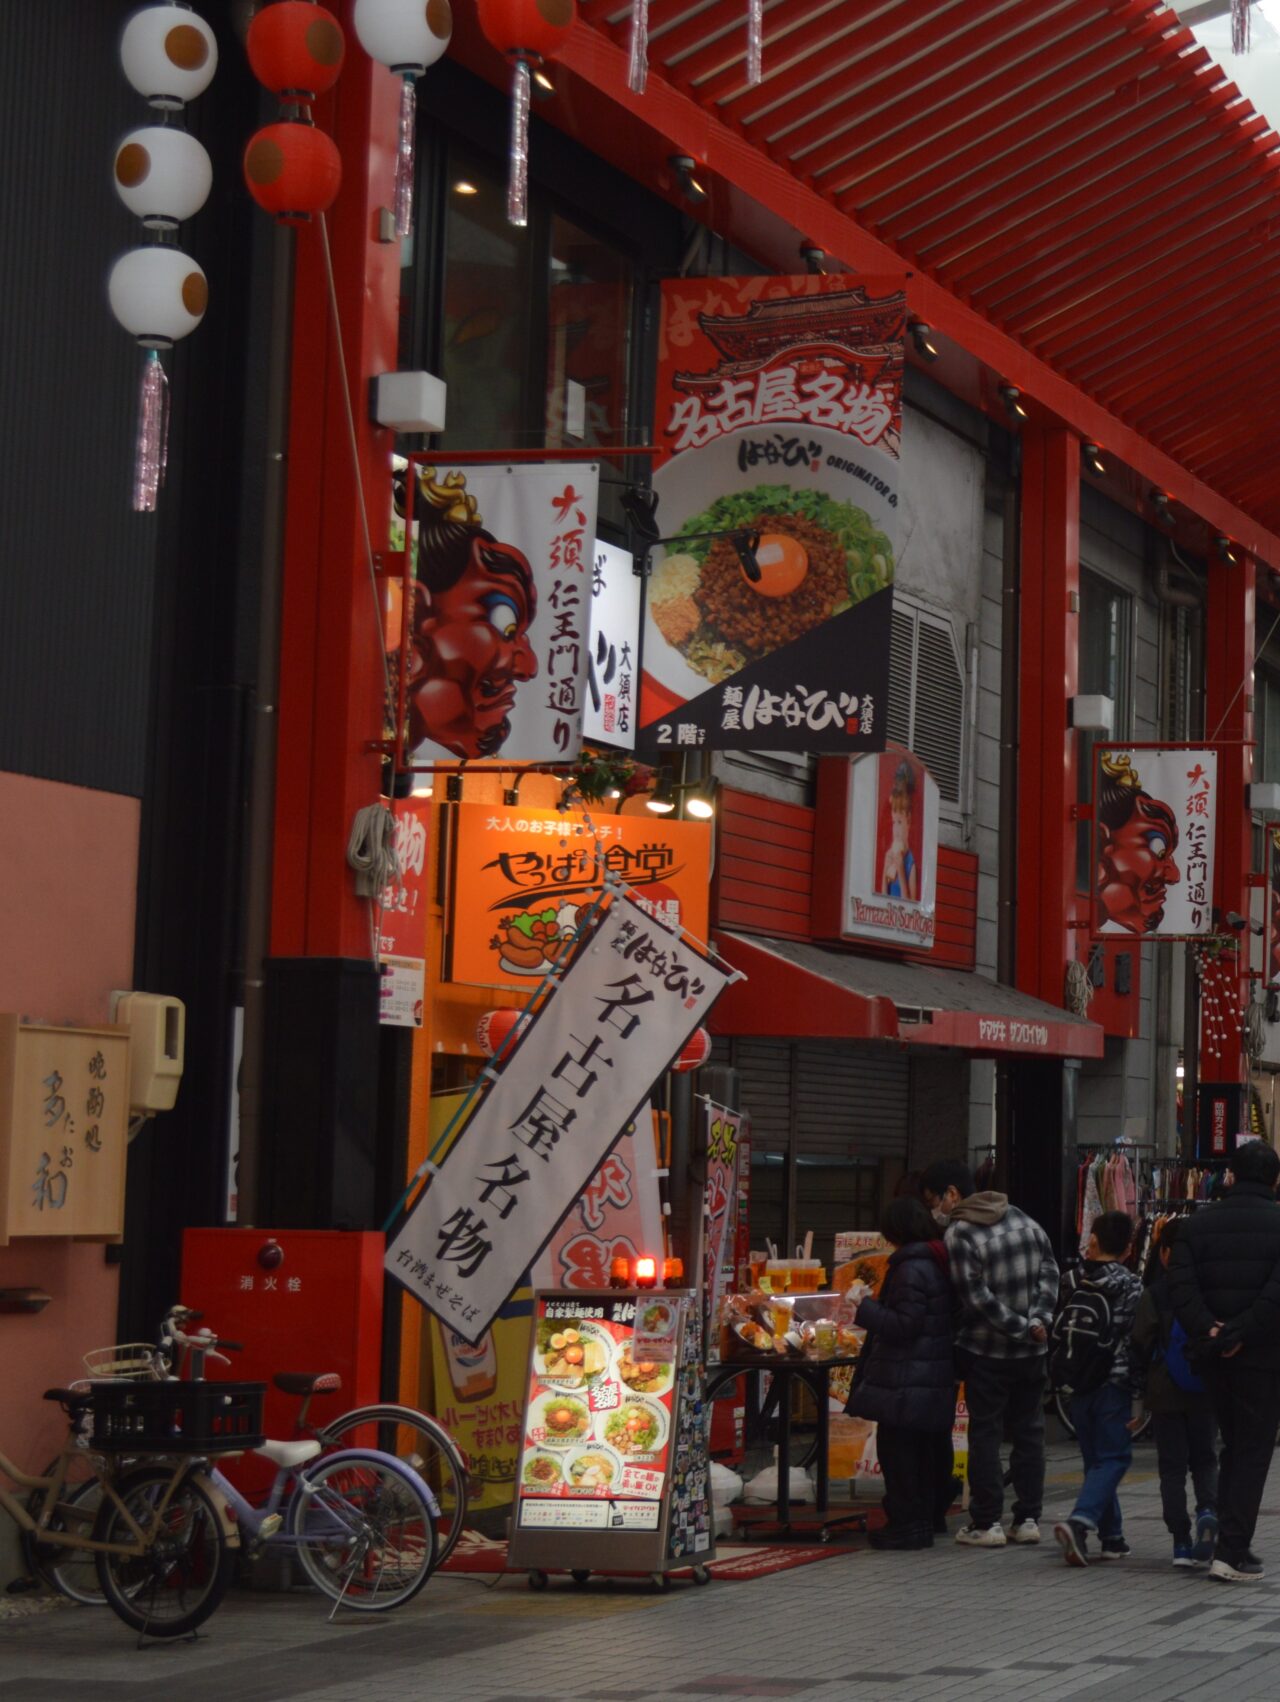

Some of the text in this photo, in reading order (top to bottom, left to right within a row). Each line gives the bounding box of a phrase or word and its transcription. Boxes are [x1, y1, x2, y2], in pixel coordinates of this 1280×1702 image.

[668, 367, 892, 449] 名古屋名物
[738, 434, 822, 472] はなび
[826, 455, 891, 497] ORIGINATOR
[547, 485, 587, 752] 大須仁王門通り
[617, 640, 632, 734] 大須店
[721, 685, 743, 730] 麺屋
[742, 684, 858, 731] はなび
[859, 694, 874, 735] 大須店
[481, 843, 686, 886] やっぱり食堂
[1186, 763, 1210, 929] 大須仁王門通り
[851, 896, 897, 928] Yamazaki
[624, 933, 705, 999] はなび
[979, 1019, 1005, 1042] ヤマザキ
[435, 972, 656, 1279] 名古屋名物
[240, 1275, 302, 1293] 消火栓
[397, 1249, 480, 1323] 台湾まぜそば
